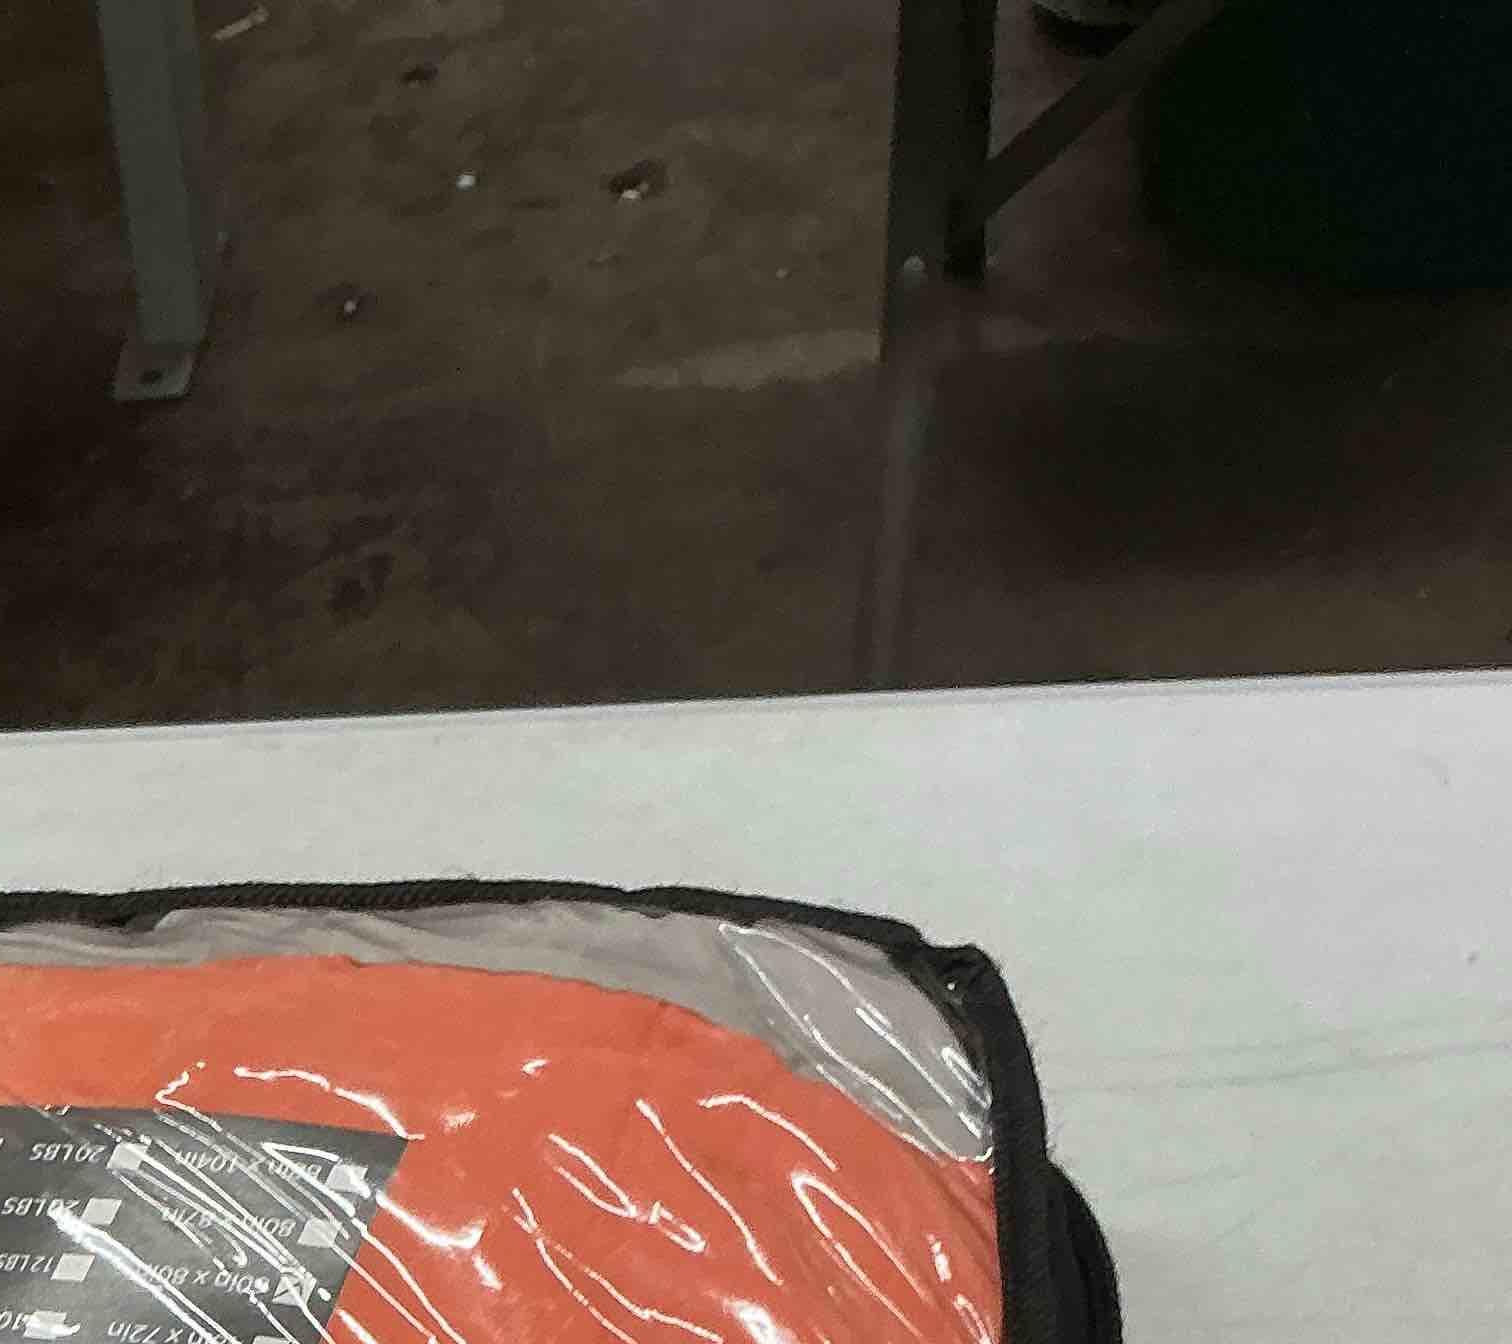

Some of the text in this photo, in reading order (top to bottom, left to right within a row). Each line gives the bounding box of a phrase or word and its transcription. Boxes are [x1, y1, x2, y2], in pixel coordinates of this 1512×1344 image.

[28, 1142, 73, 1161] LBS
[0, 1196, 46, 1217] LBS
[106, 1320, 162, 1344] 72in
